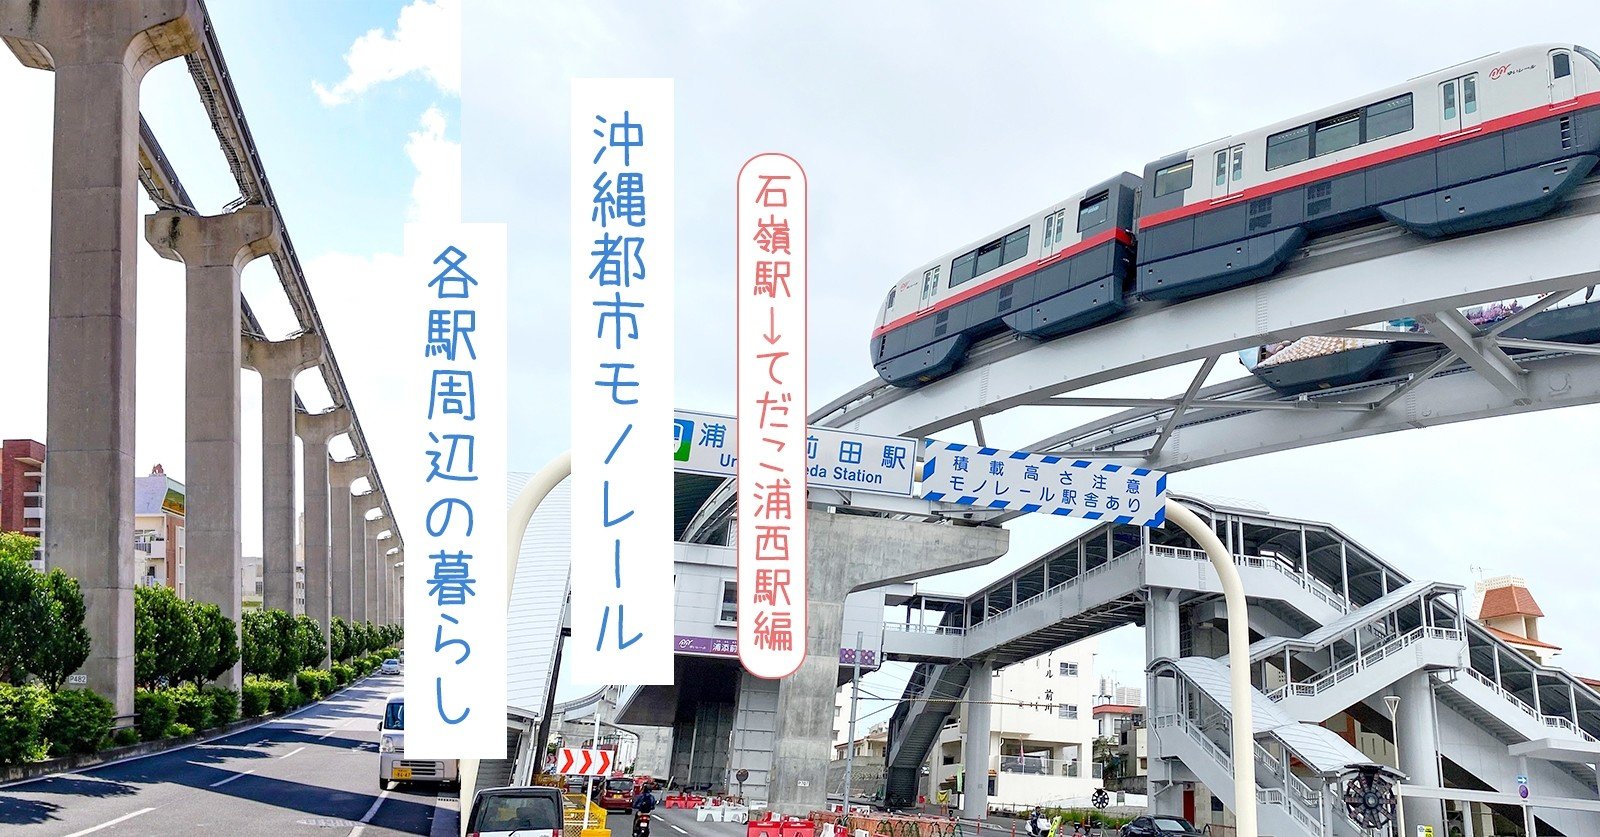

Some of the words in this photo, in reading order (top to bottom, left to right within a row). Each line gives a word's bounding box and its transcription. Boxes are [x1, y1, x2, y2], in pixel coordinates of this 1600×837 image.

[833, 466, 883, 484] Station
[952, 455, 1141, 495] 積載高さ注意
[949, 475, 1141, 513] モノレール駅舎あり
[69, 674, 87, 684] P482
